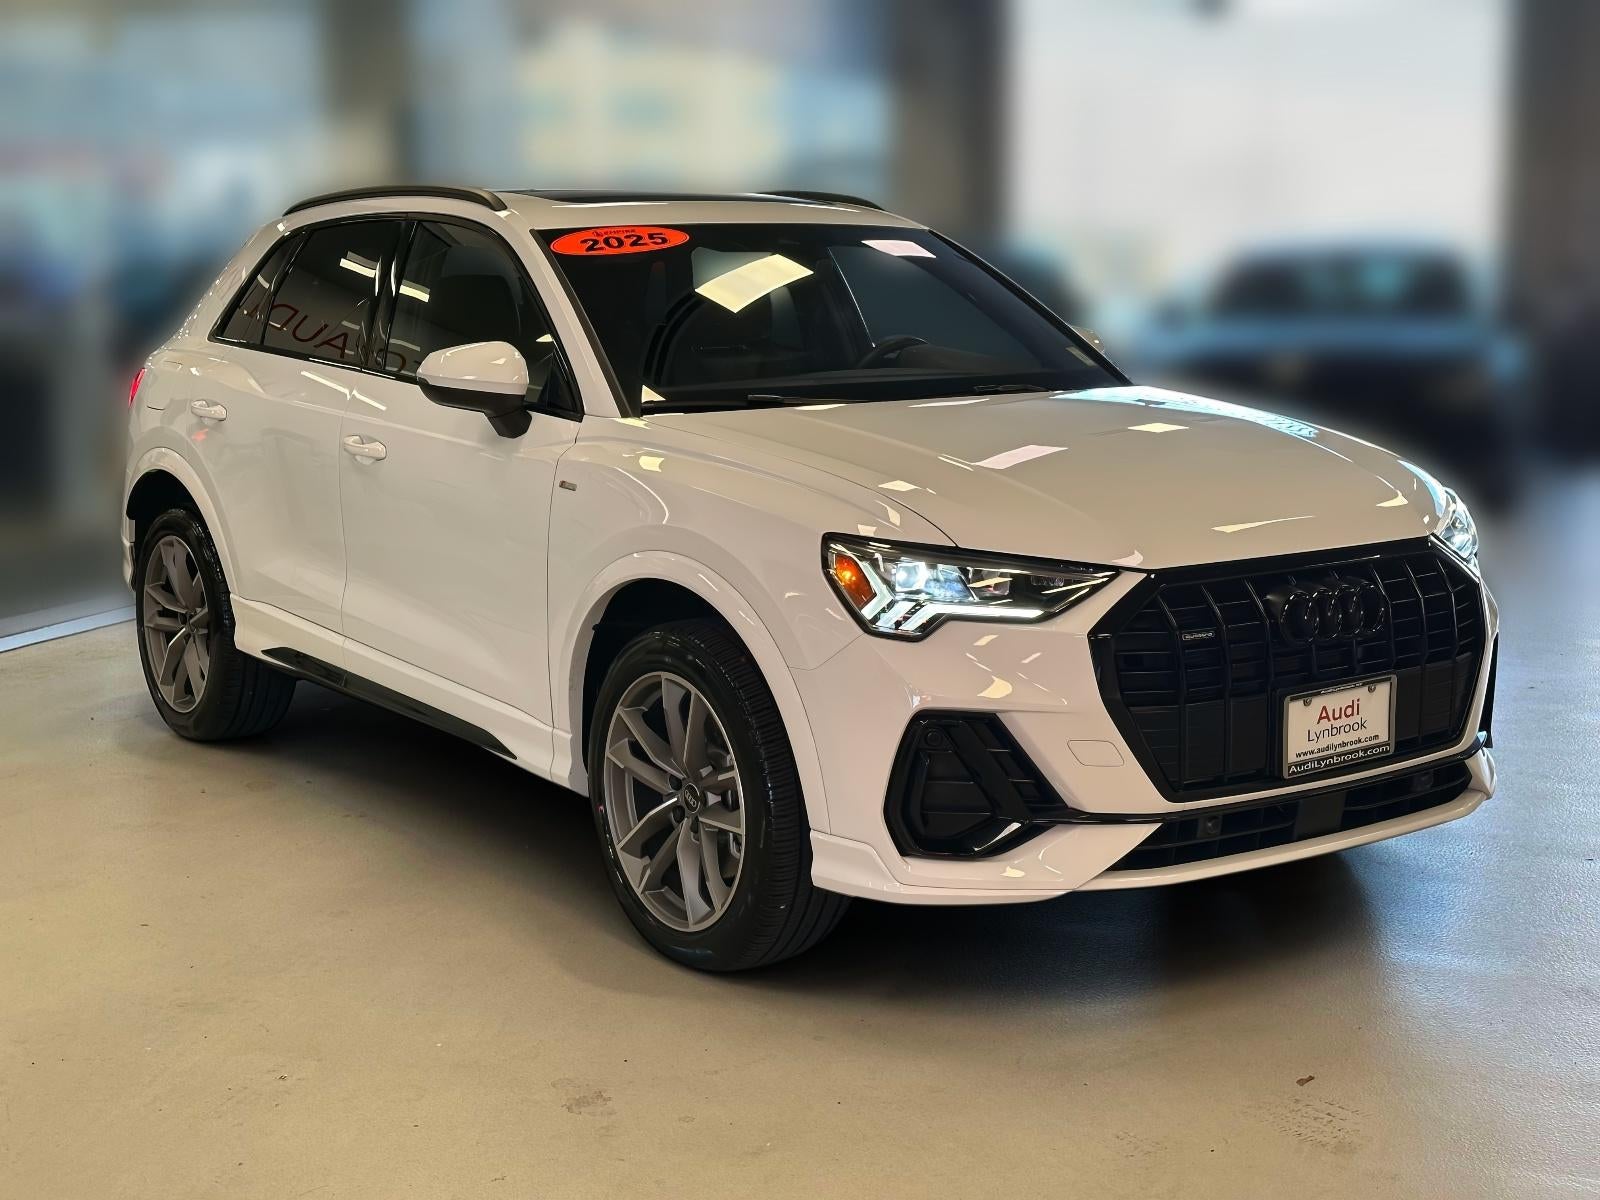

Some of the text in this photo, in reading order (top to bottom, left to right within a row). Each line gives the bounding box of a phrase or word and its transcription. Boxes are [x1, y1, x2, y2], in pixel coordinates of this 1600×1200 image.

[580, 232, 669, 253] 2025
[1317, 698, 1361, 725] Audi
[1307, 717, 1368, 743] Lynbrook
[1289, 745, 1390, 774] AudiLynbrook.com
[1295, 735, 1380, 758] www.audilynbrook.com
